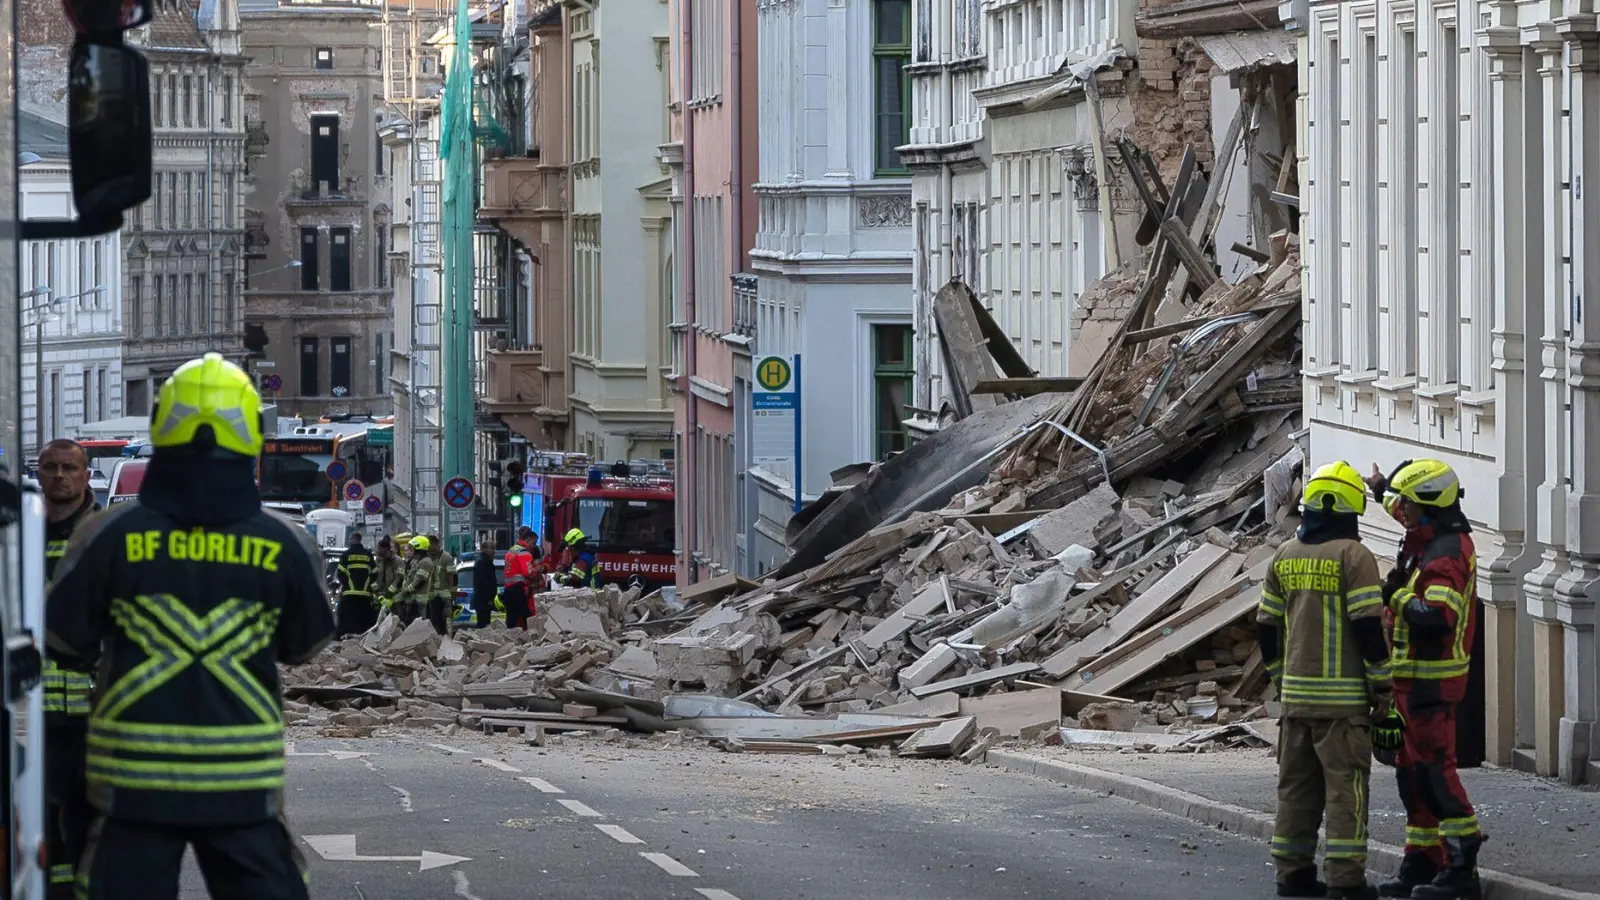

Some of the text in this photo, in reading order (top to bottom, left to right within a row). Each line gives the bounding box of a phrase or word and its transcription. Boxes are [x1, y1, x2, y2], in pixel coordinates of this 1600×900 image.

[766, 363, 780, 384] H
[126, 527, 282, 572] BF GÖRLITZ
[597, 561, 677, 574] FEUERWEHR
[1280, 573, 1340, 592] ERWEHR
